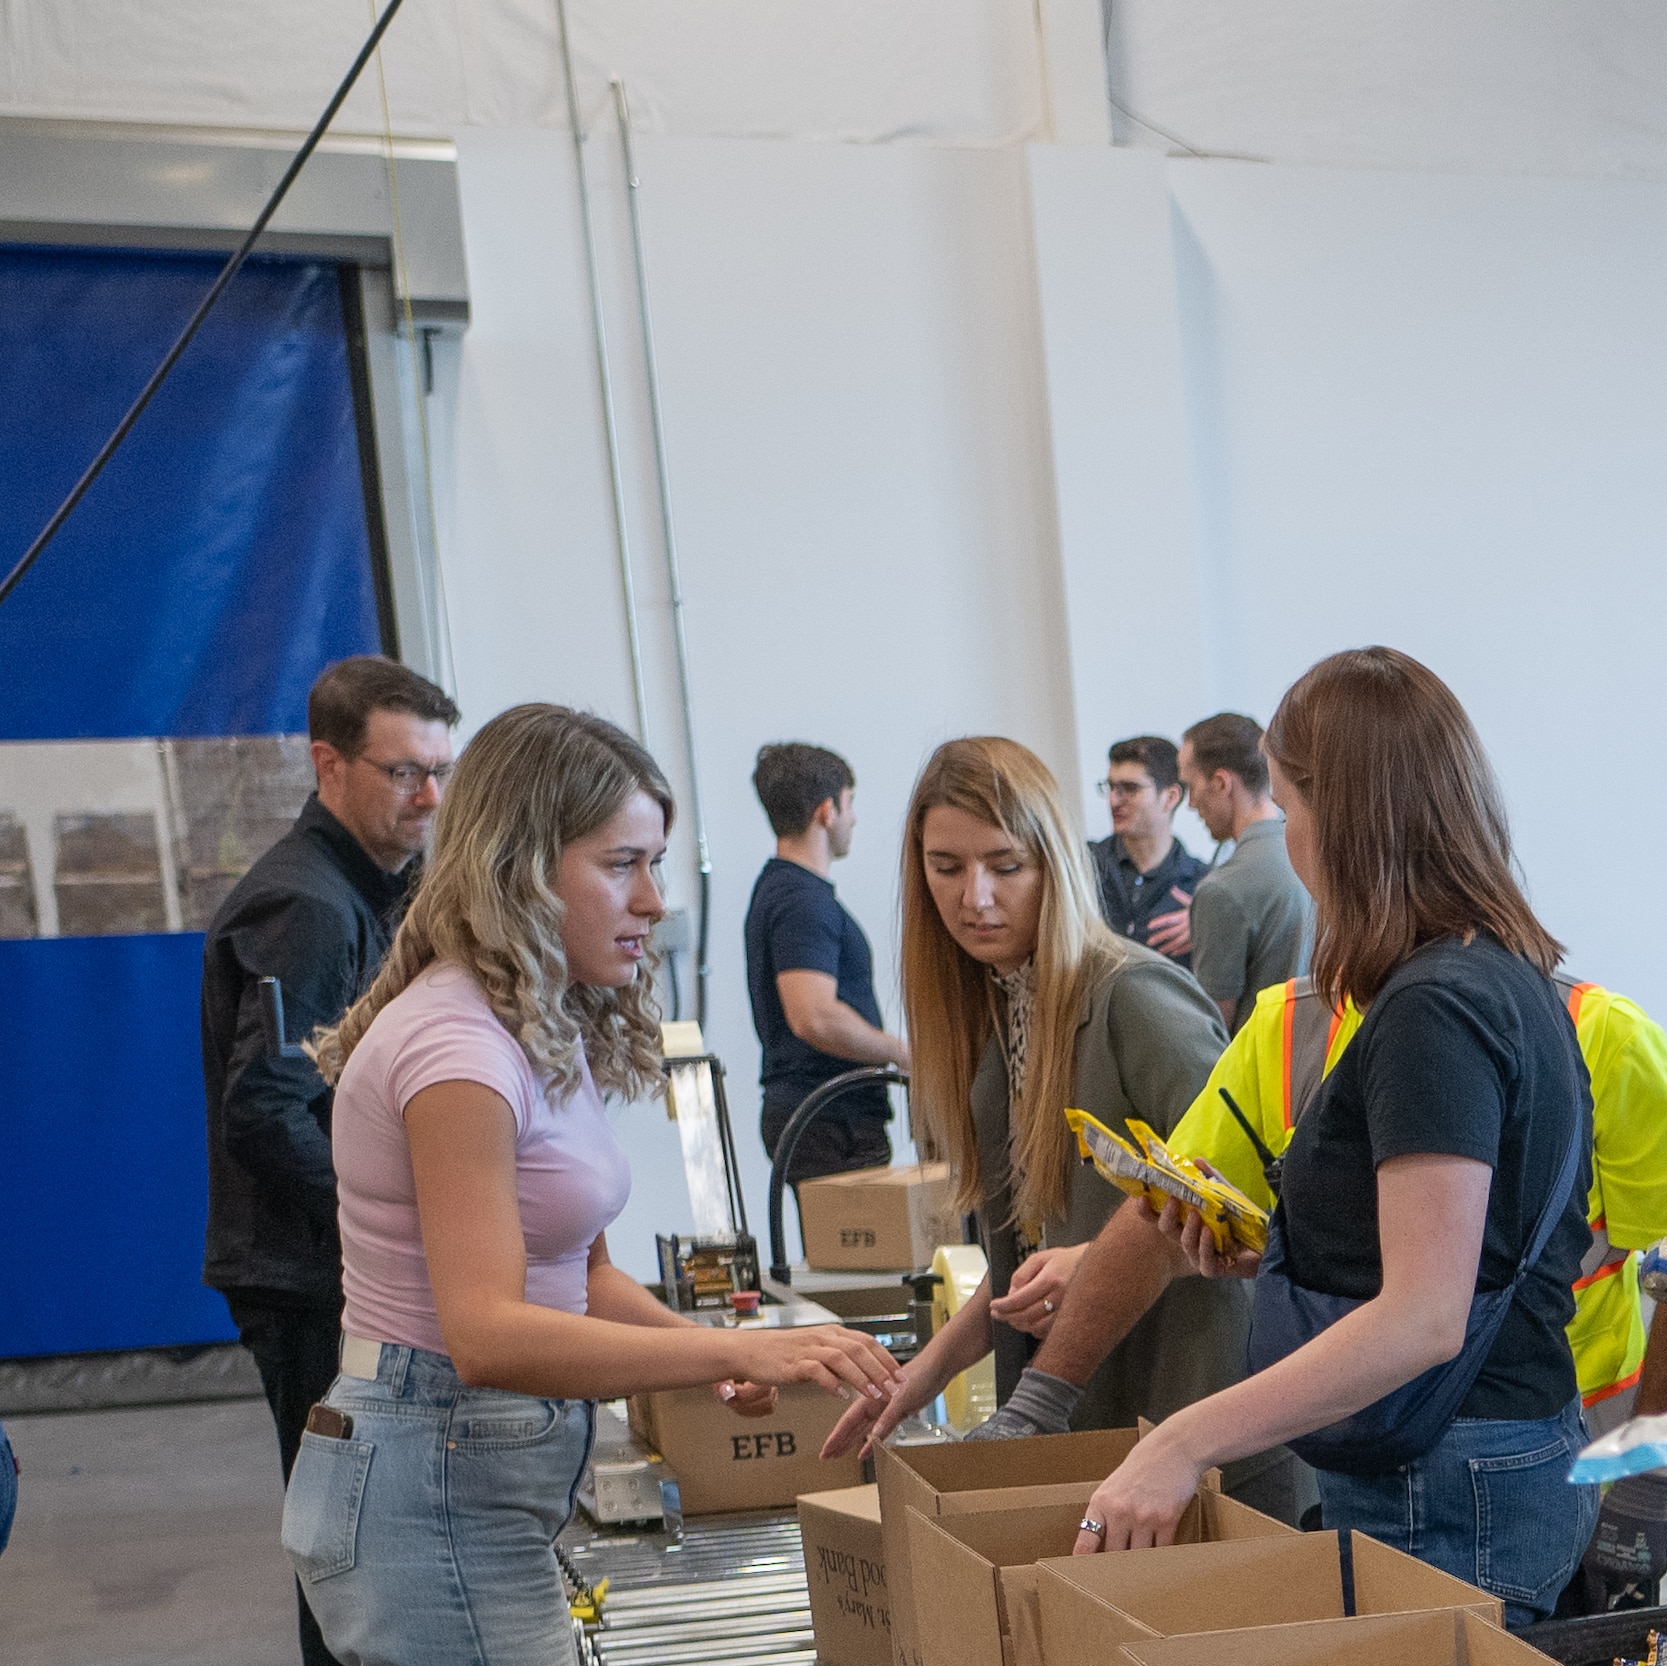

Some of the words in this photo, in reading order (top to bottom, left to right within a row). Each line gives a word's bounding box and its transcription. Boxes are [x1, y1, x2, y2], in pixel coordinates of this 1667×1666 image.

[840, 1228, 876, 1248] EFB
[730, 1430, 797, 1461] EFB
[817, 1546, 859, 1593] Bank
[837, 1592, 875, 1630] Mary's
